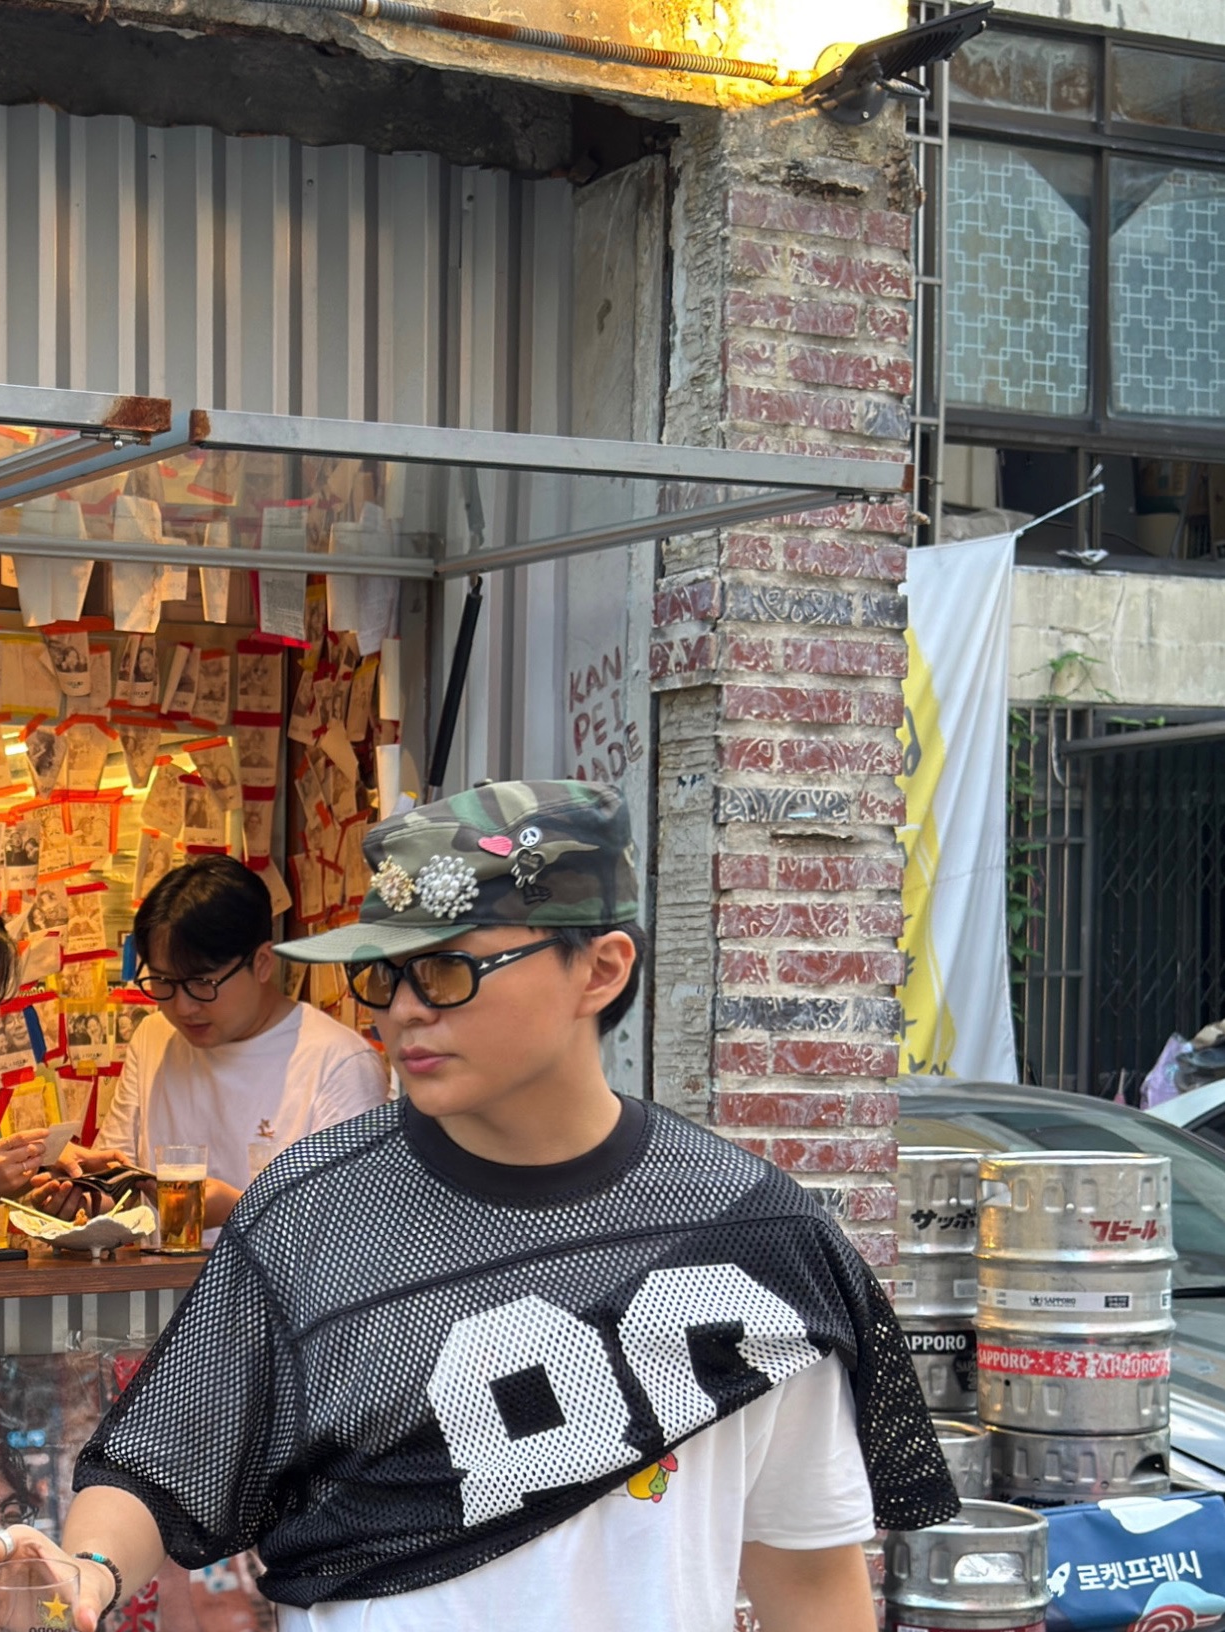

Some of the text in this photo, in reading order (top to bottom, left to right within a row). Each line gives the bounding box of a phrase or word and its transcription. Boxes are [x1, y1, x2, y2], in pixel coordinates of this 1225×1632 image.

[569, 646, 622, 713] KAN
[573, 688, 624, 756] PEI
[902, 1334, 967, 1351] APPORO
[1077, 1550, 1203, 1591] 로켓프레시
